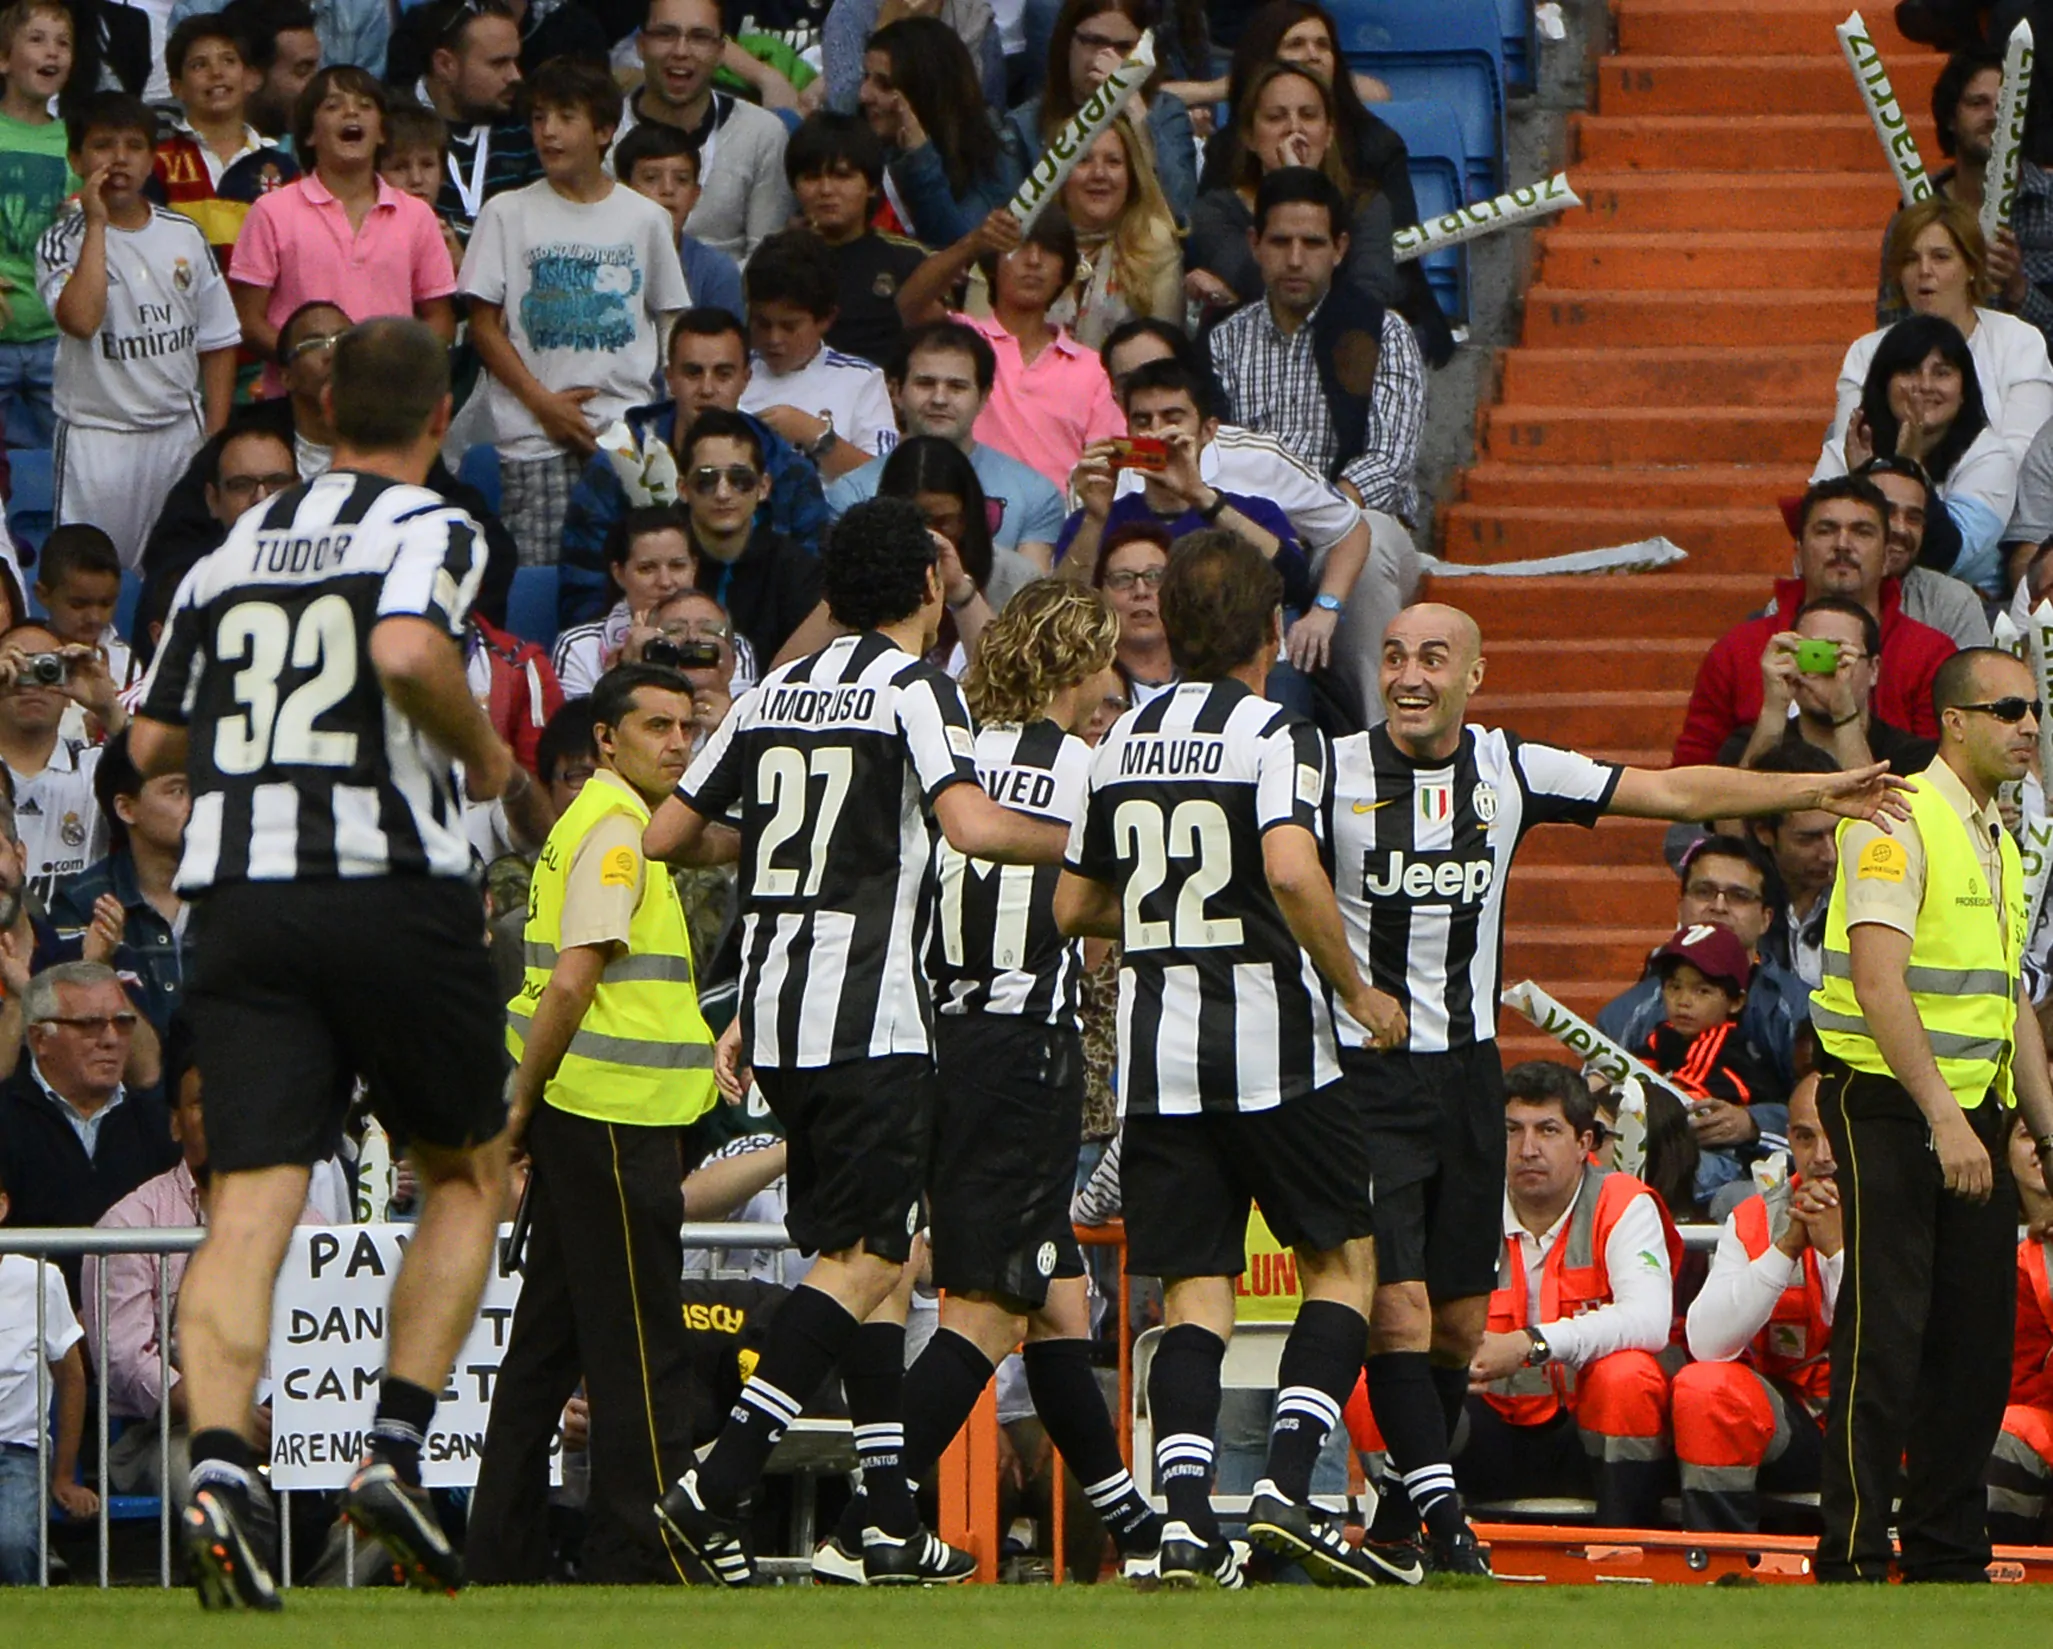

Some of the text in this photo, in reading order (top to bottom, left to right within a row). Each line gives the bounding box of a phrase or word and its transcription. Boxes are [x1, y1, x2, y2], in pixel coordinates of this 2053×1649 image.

[1007, 73, 1128, 222] veracru
[1848, 34, 1933, 202] eracruz
[1391, 176, 1566, 249] eracruz
[138, 303, 171, 325] Fly
[252, 534, 352, 573] TUDOR
[213, 594, 358, 774] 32
[978, 769, 1056, 809] VED
[1120, 740, 1224, 775] MAURO
[751, 746, 853, 896] 27
[1113, 799, 1244, 952] 22
[1366, 851, 1493, 904] Jeep
[1541, 1006, 1649, 1084] vera
